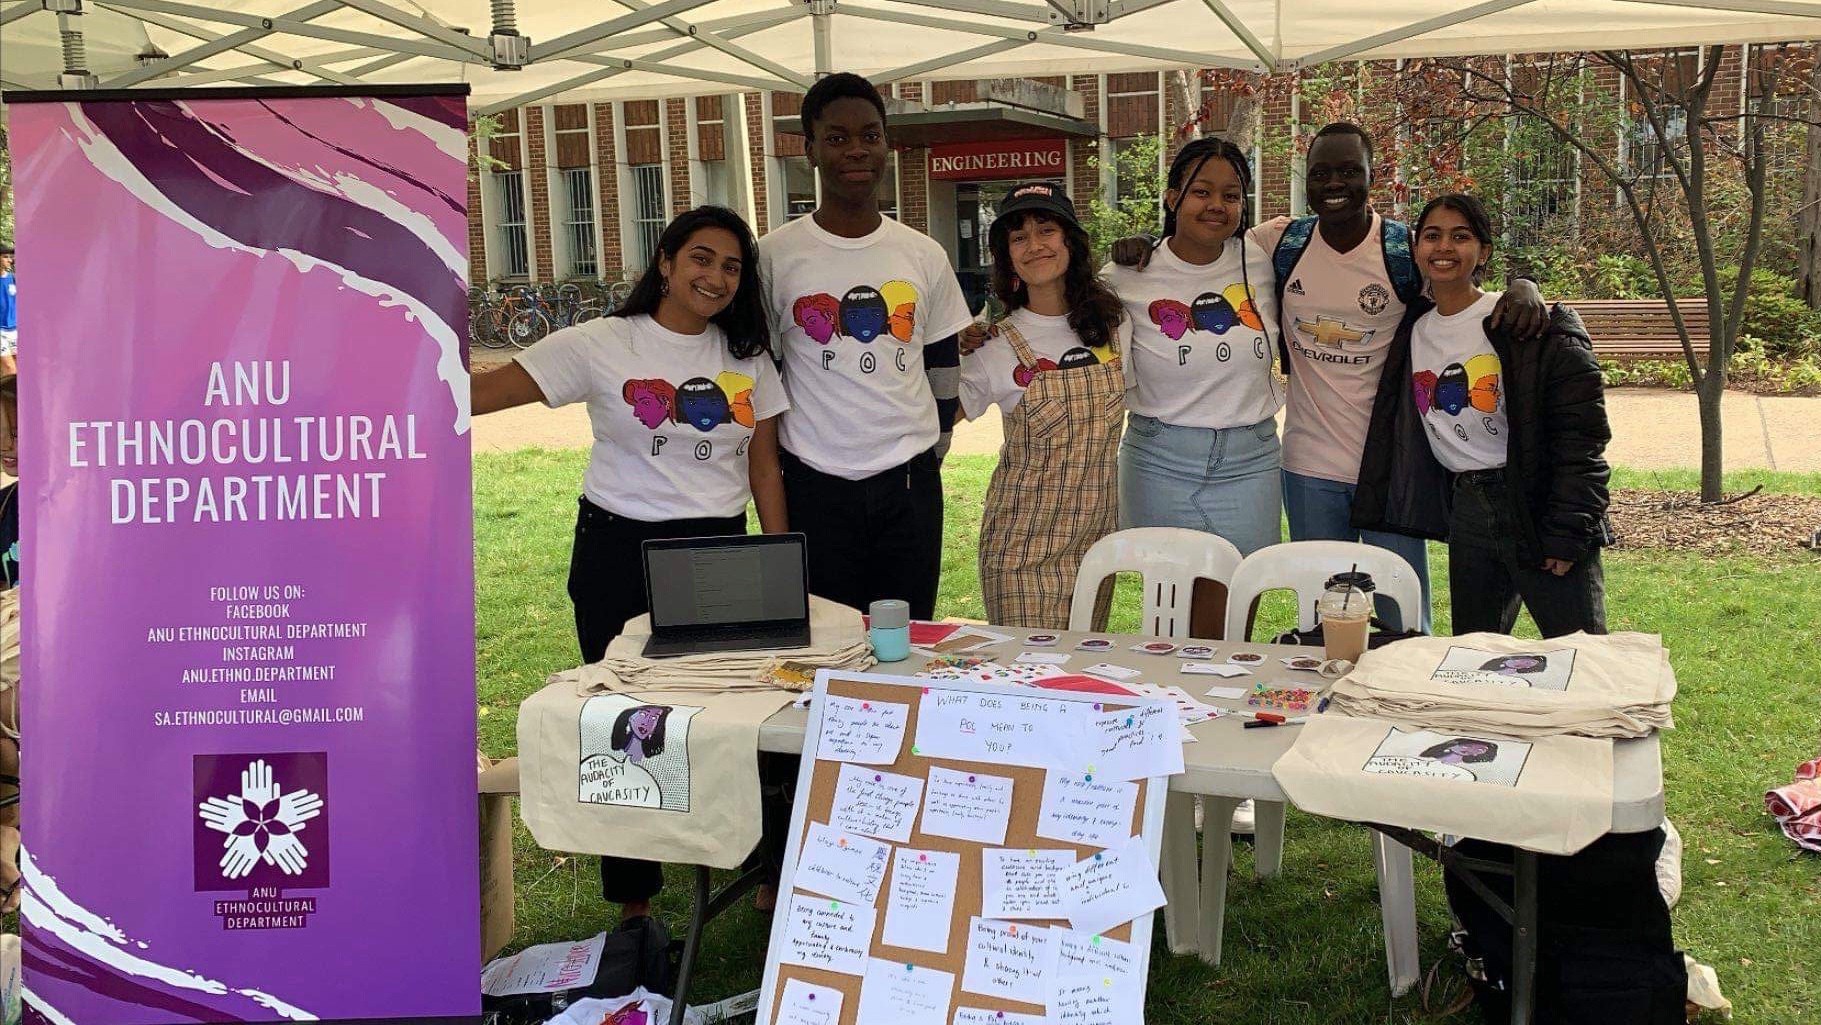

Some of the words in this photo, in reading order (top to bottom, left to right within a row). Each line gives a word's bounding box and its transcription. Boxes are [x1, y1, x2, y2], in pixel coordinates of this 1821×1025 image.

[932, 151, 1062, 172] ENGINEERING
[1293, 341, 1374, 365] CEVROLET
[204, 360, 291, 406] ANU
[69, 414, 427, 467] ETHNOCULTURAL
[111, 473, 386, 524] DEPARTMENT
[211, 587, 259, 602] FOLLOW
[264, 586, 280, 599] US
[284, 585, 305, 599] ON:
[226, 604, 290, 619] FACEBOOK
[148, 628, 174, 642] ANU
[179, 626, 282, 641] ETHNOCULTURAL
[287, 623, 368, 639] DEPARTMENT
[223, 646, 294, 661] INSTAGRAM
[182, 666, 335, 683] ANU.ETHNO.DEPARTMENT
[240, 689, 277, 703] EMAIL
[937, 695, 968, 708] WHAT
[980, 698, 1002, 709] DOES
[1020, 701, 1048, 712] BEING
[155, 707, 363, 726] SA.ETHNOCULTURAL@GMAIL.COM
[991, 722, 1015, 732] MEAN
[1022, 723, 1033, 732] TO
[985, 740, 1012, 754] YOU?
[588, 759, 608, 770] THE
[581, 765, 625, 785] AUDACITY
[602, 779, 615, 788] OF
[590, 786, 650, 803] CAUCASITY
[252, 887, 277, 898] ANU
[216, 901, 314, 914] ETHNOCULTURAL
[228, 916, 303, 929] DEPARTMENT
